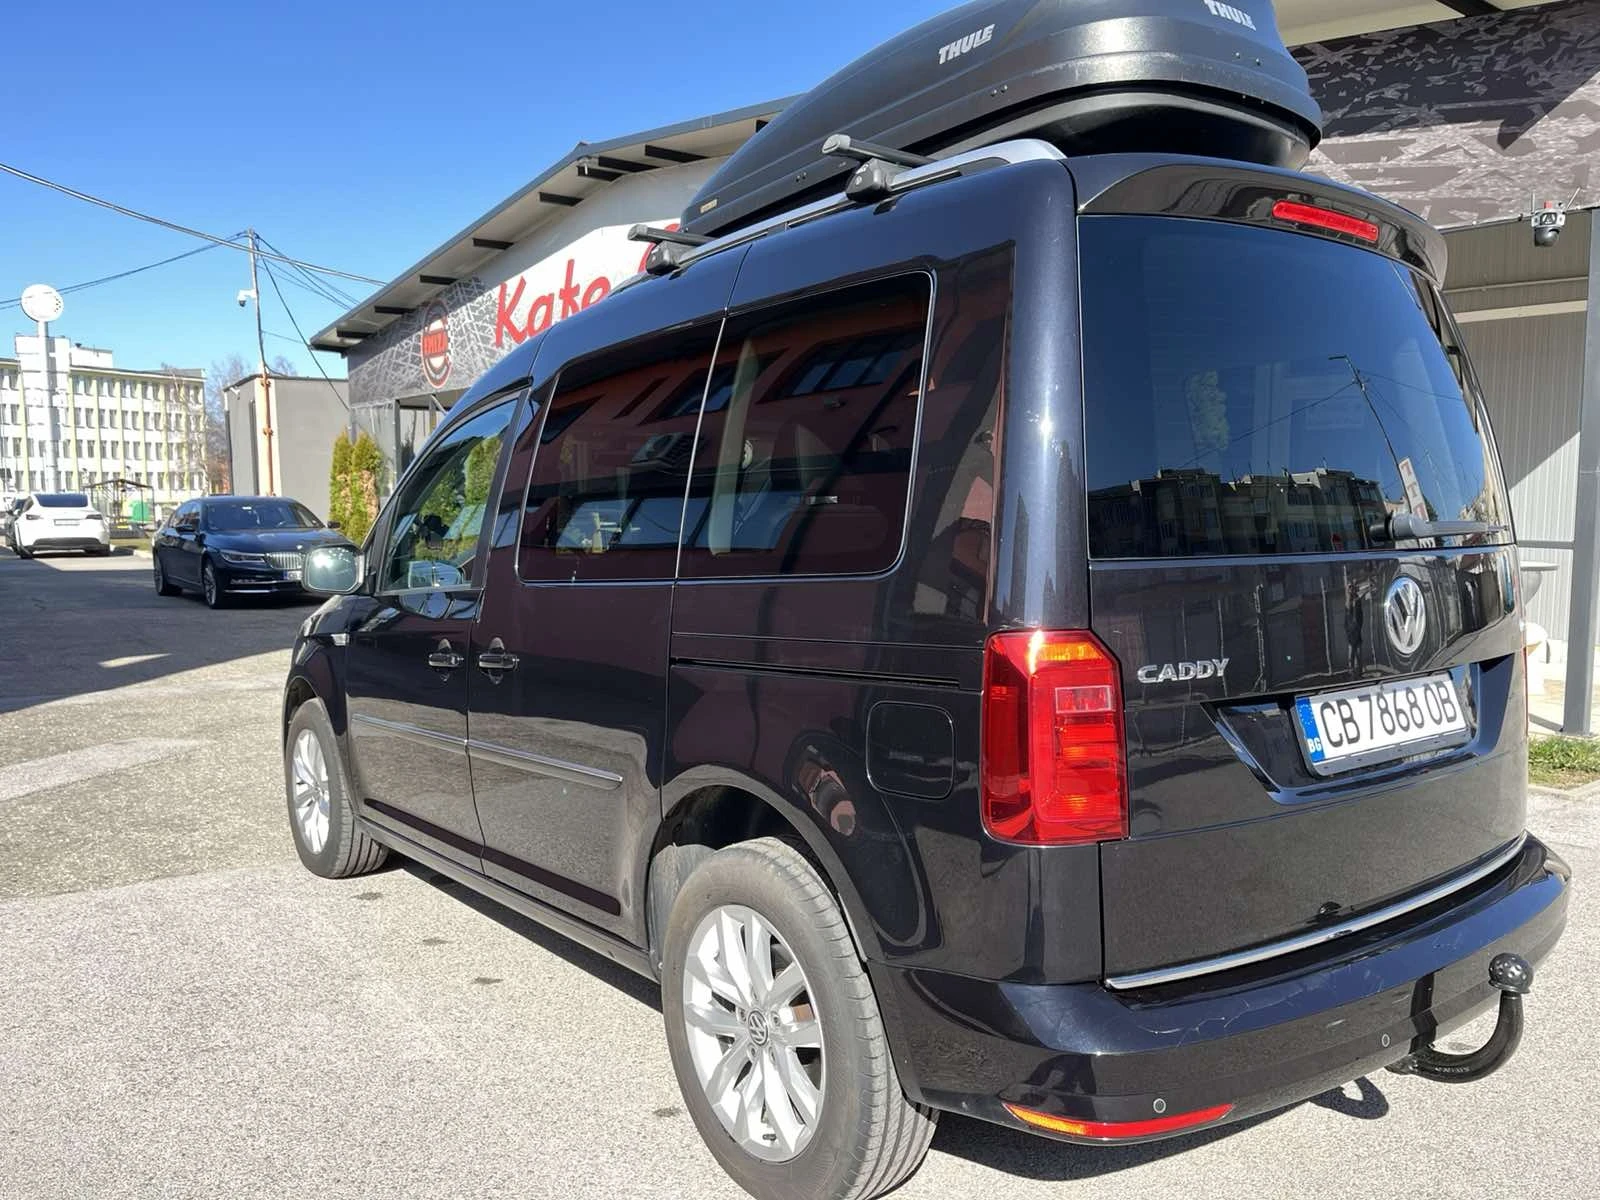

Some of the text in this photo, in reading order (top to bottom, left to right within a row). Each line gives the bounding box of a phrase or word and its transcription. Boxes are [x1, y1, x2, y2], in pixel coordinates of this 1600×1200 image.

[1203, 0, 1257, 31] THULE
[938, 23, 996, 65] THULE
[1137, 657, 1230, 684] CADDY
[1307, 738, 1322, 753] BG
